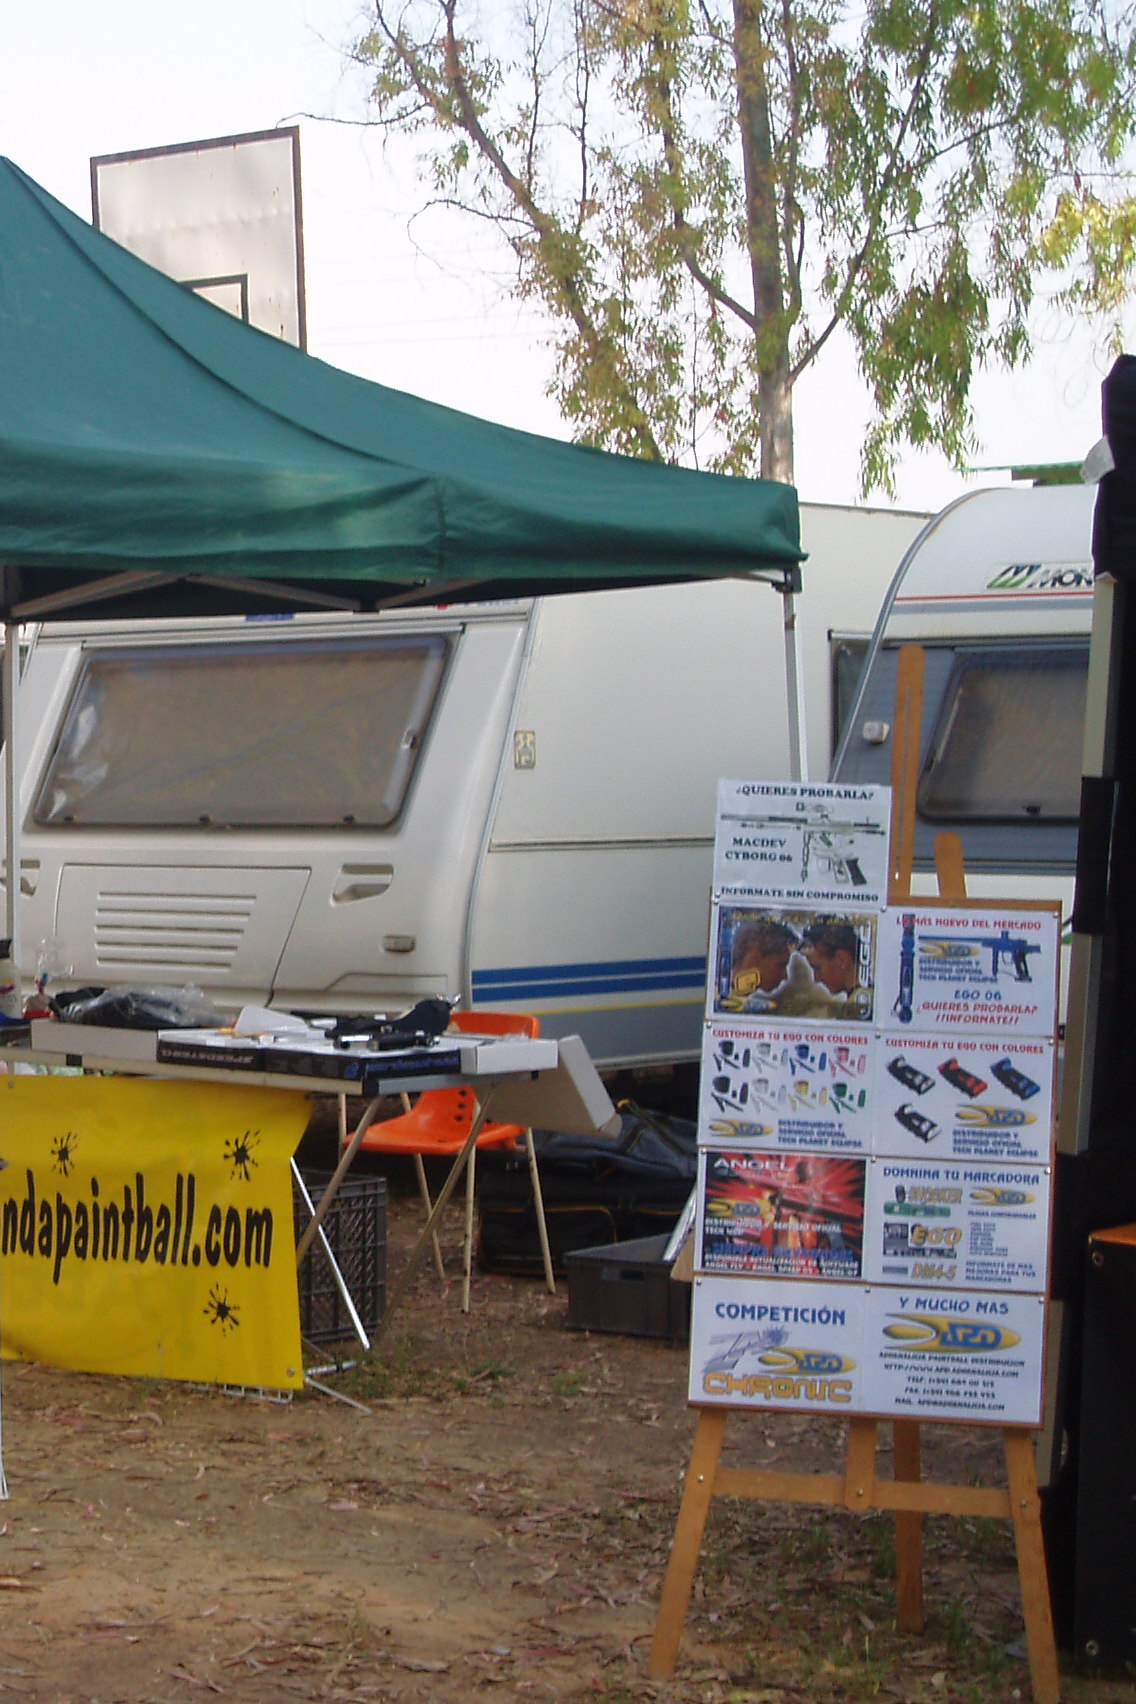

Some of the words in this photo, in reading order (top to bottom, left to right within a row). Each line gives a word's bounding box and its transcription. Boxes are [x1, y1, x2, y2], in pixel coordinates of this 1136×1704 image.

[800, 786, 874, 800] PROBARLA?
[732, 837, 787, 848] MACDEV
[725, 850, 777, 862] CYBORG
[786, 890, 804, 899] SIN
[805, 891, 879, 902] COMPROMISO
[972, 919, 990, 928] DEL
[993, 919, 1041, 930] MERCADO
[954, 989, 980, 1000] EGO
[973, 1002, 1038, 1015] PROBARLA?
[712, 1029, 764, 1040] CUSTOMIZA
[769, 1032, 780, 1041] TU
[805, 1034, 824, 1043] CON
[827, 1034, 868, 1045] COLORES
[885, 1038, 938, 1049] CUSTOMIZA
[942, 1041, 954, 1049] TU
[980, 1042, 999, 1051] CON
[1002, 1043, 1044, 1054] COLORES
[714, 1158, 786, 1170] ANGEL
[945, 1170, 959, 1180] TU
[964, 1171, 1039, 1185] MARCADORA
[912, 1225, 963, 1246] EGO
[899, 1296, 908, 1309] Y
[915, 1297, 970, 1312] MUCHO
[976, 1300, 1009, 1314] MAS
[715, 1303, 846, 1325] COMPETICIÓN
[703, 1372, 853, 1402] CHRONIC
